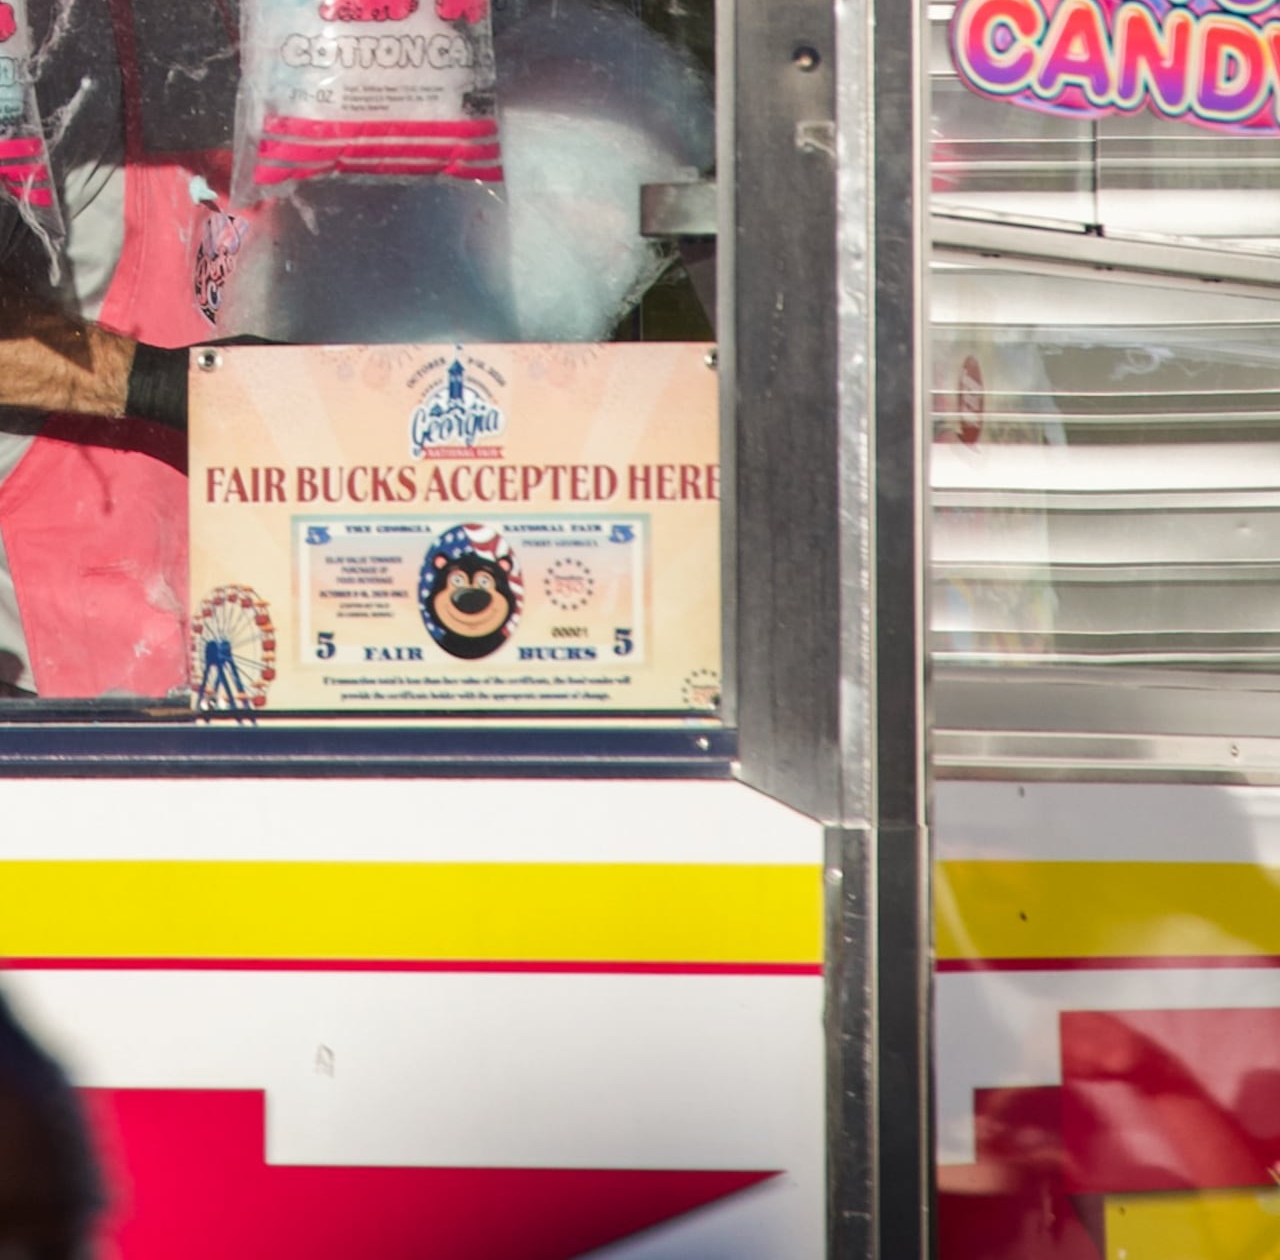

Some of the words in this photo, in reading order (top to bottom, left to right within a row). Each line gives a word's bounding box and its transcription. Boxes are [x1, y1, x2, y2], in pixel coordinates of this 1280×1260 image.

[412, 403, 499, 457] Georgia
[205, 467, 287, 504] FAIR
[296, 464, 418, 503] BUCKS
[425, 463, 618, 502] ACCEPTED
[629, 463, 721, 501] HERE
[316, 632, 336, 659] 5
[363, 646, 424, 661] FAIR
[519, 645, 597, 661] BUCKS
[613, 627, 634, 656] 5
